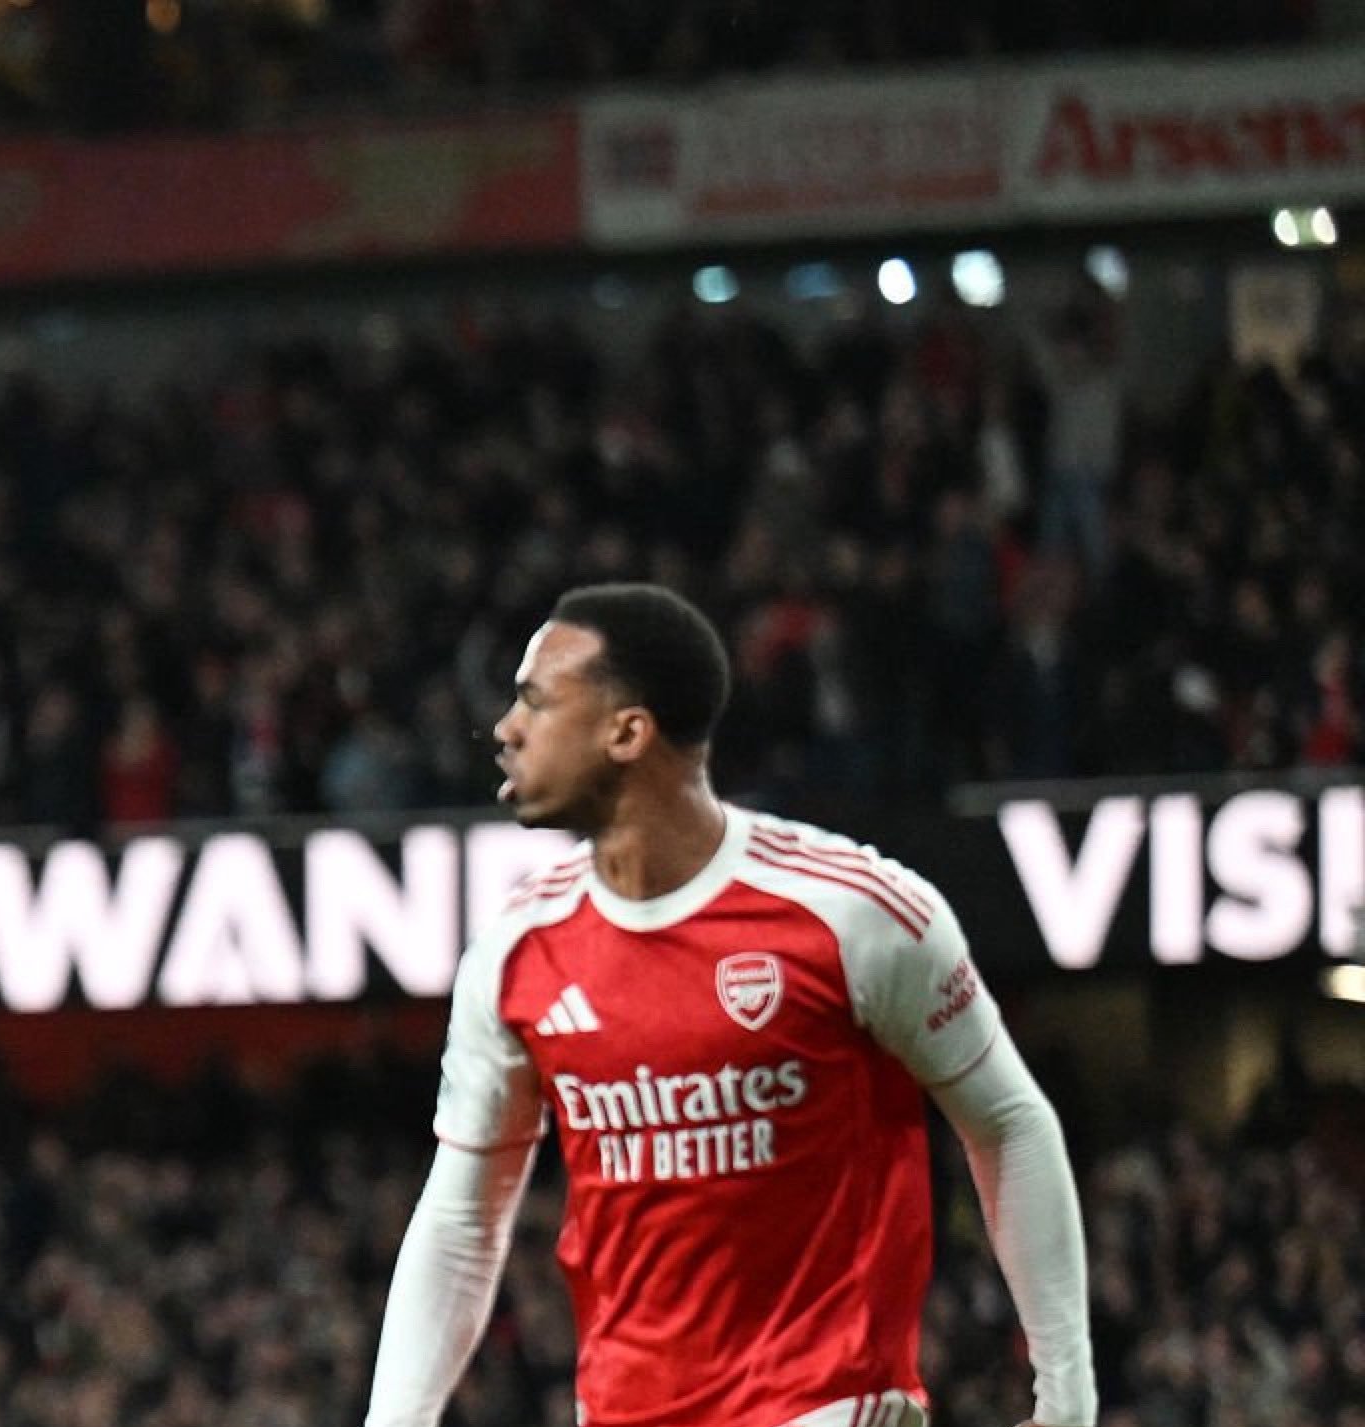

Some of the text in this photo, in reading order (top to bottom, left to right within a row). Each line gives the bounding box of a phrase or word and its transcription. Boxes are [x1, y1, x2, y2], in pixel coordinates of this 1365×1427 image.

[999, 788, 1365, 970] VISI
[553, 1060, 807, 1131] Emirates
[598, 1118, 775, 1183] FLY BETTER
